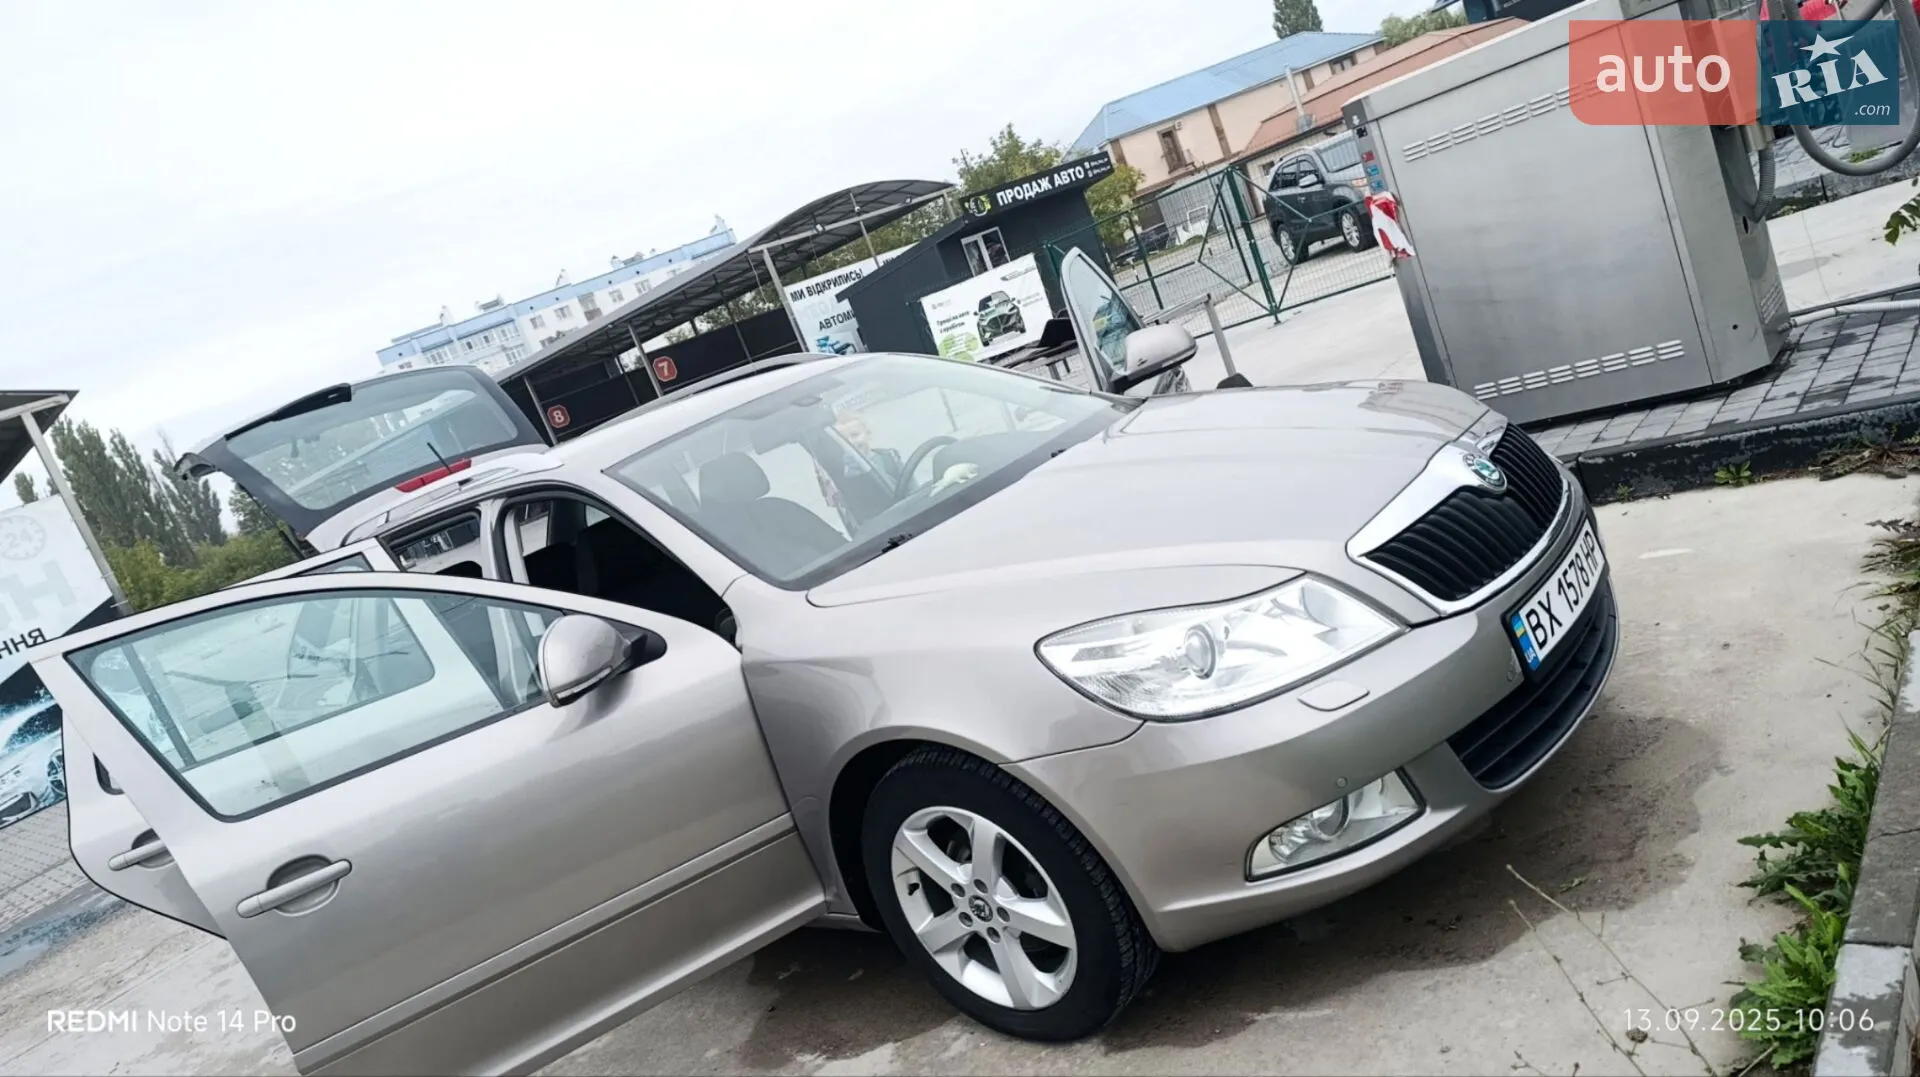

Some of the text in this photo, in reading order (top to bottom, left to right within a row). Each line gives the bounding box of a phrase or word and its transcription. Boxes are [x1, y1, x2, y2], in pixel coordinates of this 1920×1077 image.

[995, 165, 1085, 207] ПРОДАЖ АВТО
[790, 268, 864, 303] МИ ВІДКРИЛИСЬ!
[658, 361, 669, 377] 7
[553, 410, 565, 424] 8
[1525, 530, 1599, 651] BX 1578 HP
